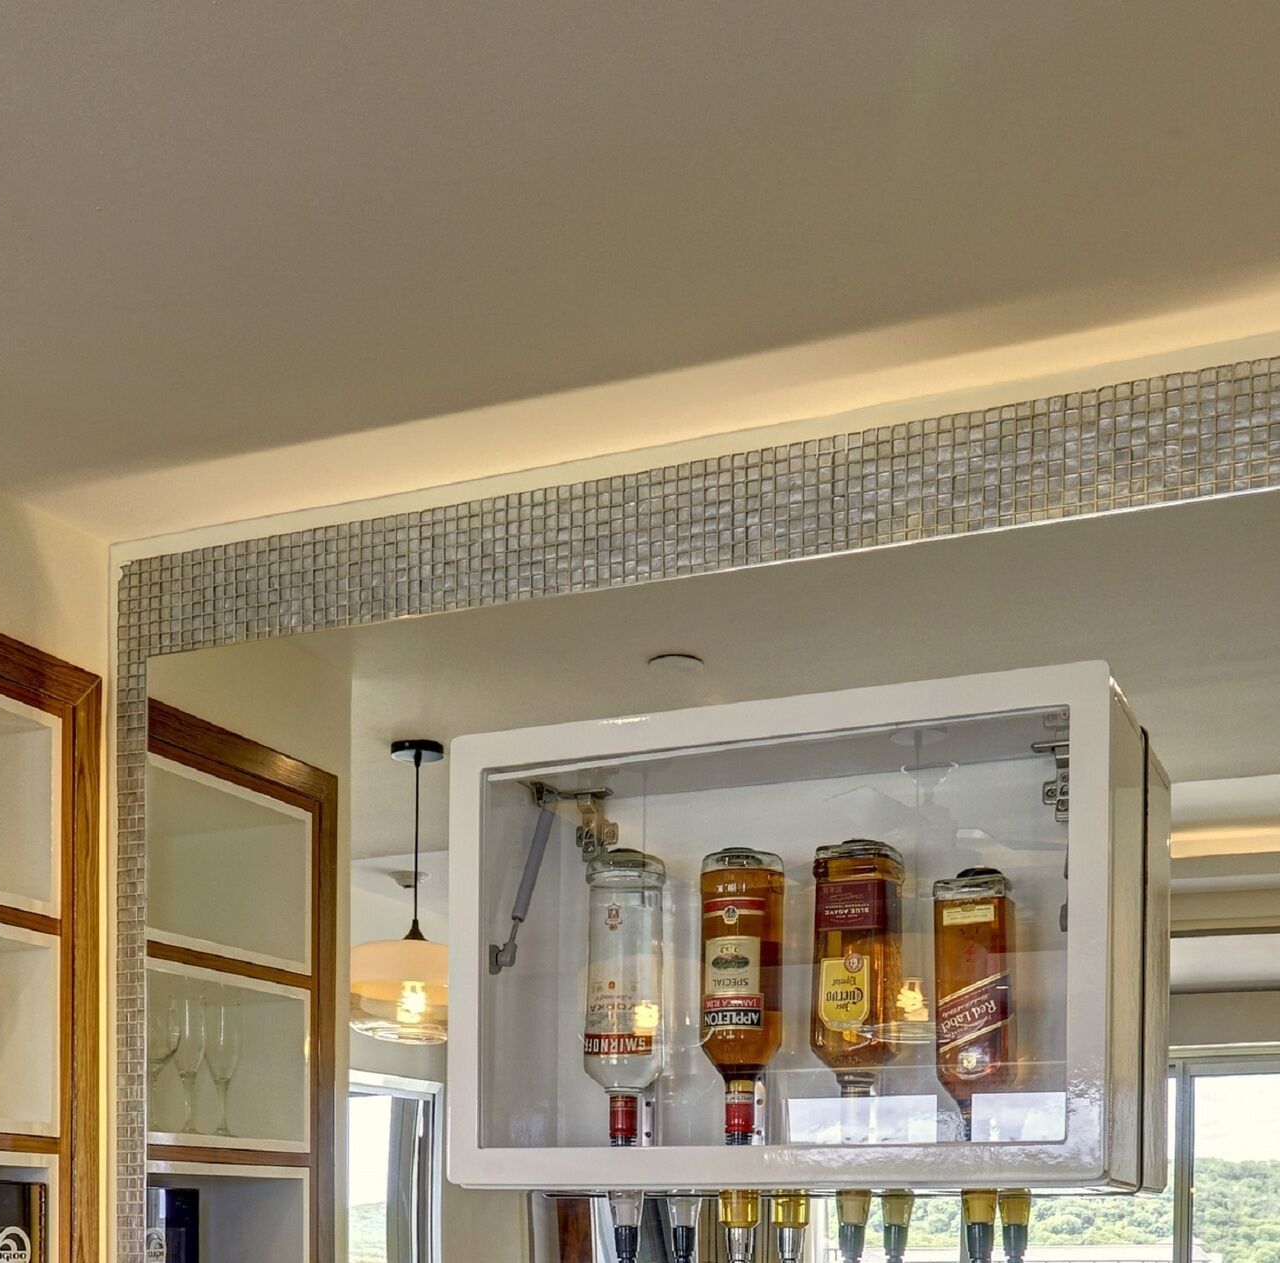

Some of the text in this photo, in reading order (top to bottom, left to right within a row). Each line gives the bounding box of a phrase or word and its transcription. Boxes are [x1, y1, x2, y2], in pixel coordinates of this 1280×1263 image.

[712, 978, 749, 987] SPECIAL
[826, 987, 864, 1005] Cuervo
[970, 999, 997, 1019] Red
[704, 1012, 760, 1026] APPLETON
[940, 1011, 972, 1033] Label
[584, 1037, 646, 1053] SMIRNOFF
[0, 1252, 27, 1261] IGLOO
